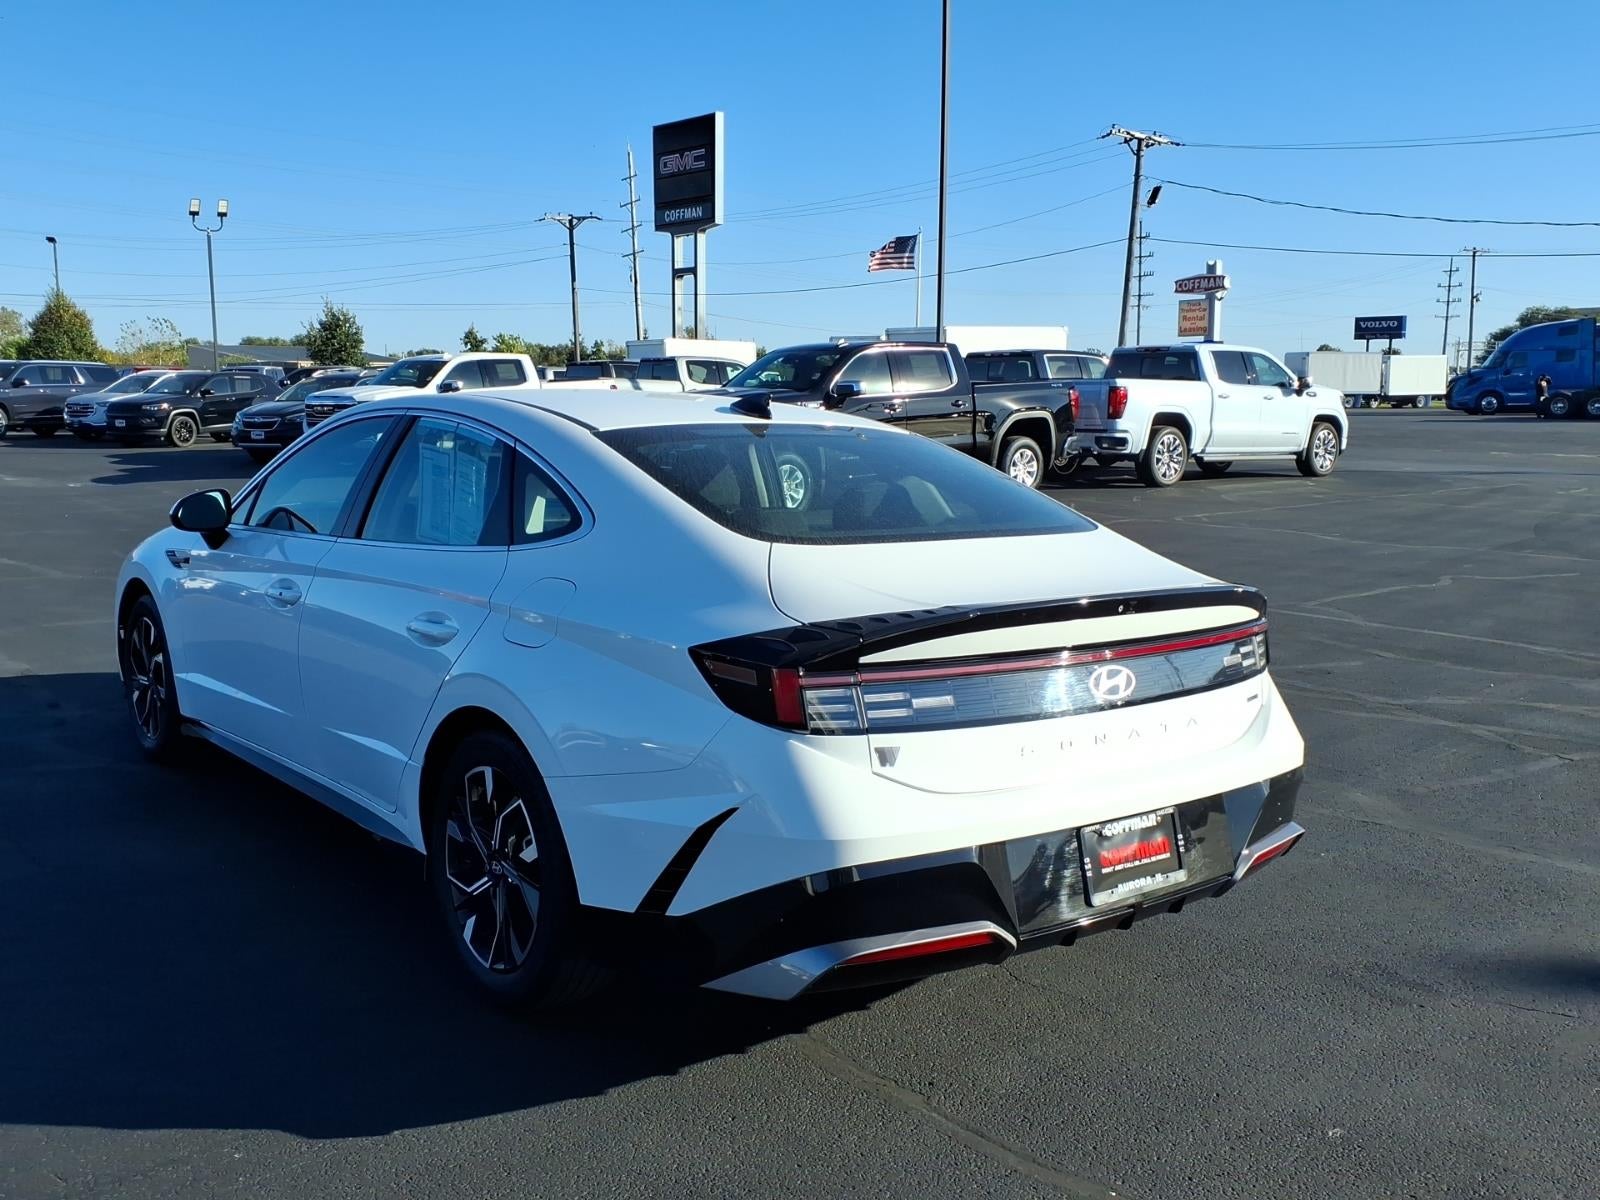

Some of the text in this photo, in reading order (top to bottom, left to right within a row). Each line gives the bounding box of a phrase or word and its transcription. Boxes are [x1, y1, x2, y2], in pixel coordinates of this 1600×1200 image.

[660, 148, 705, 174] GMC
[664, 206, 703, 222] COFFMAN
[1176, 277, 1223, 291] COFFMAN
[1182, 314, 1206, 322] Rental
[1360, 320, 1398, 328] VOLVO
[1180, 326, 1208, 334] Leasing
[1020, 717, 1198, 757] ONATA
